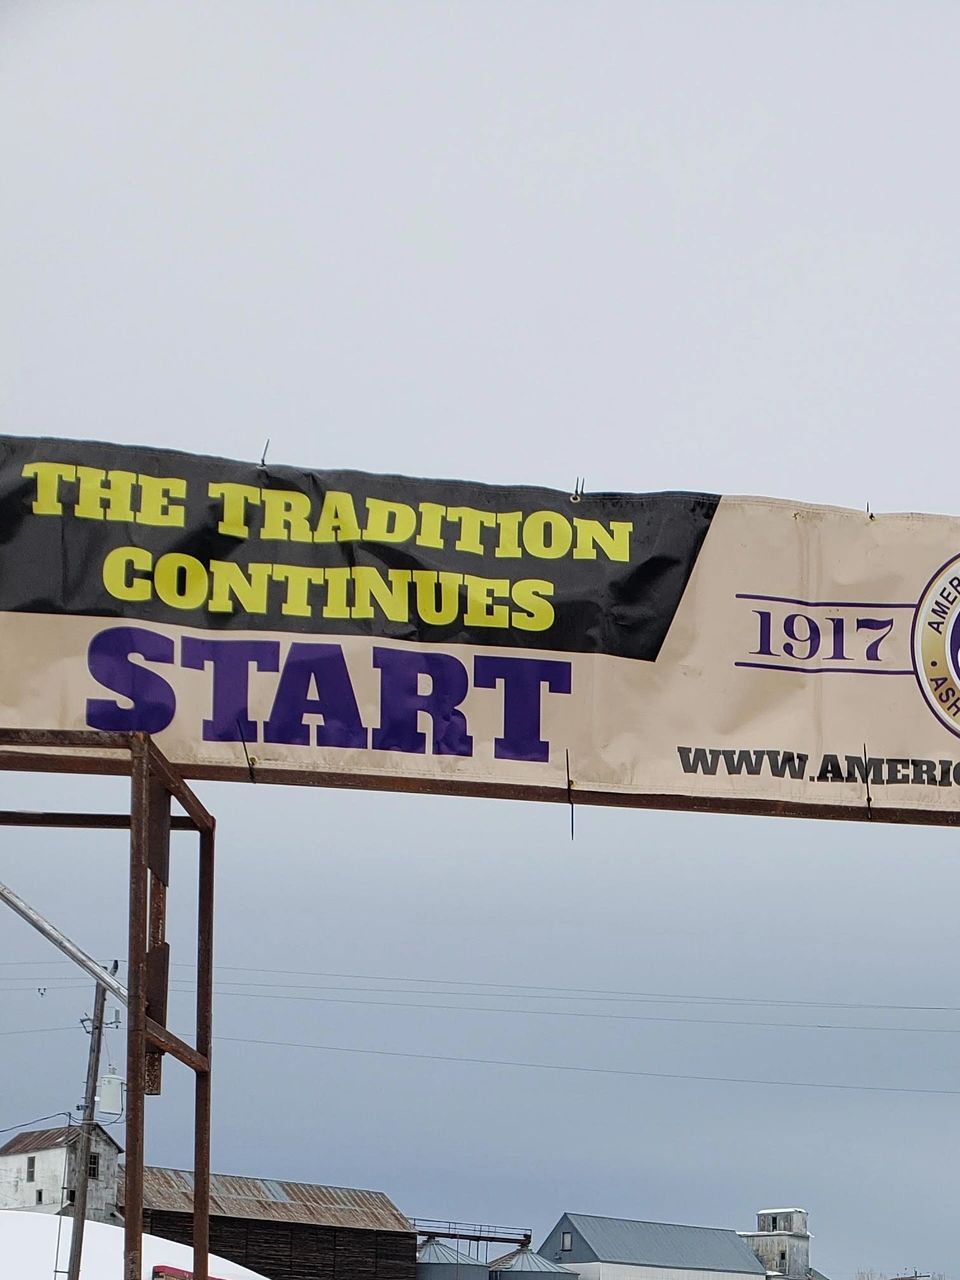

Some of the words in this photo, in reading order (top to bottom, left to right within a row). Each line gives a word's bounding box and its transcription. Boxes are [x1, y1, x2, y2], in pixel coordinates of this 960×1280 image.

[21, 462, 187, 527] THE
[208, 482, 633, 562] TRADITION
[102, 546, 555, 632] CONTINUES
[748, 609, 894, 662] 1917
[85, 626, 572, 763] START
